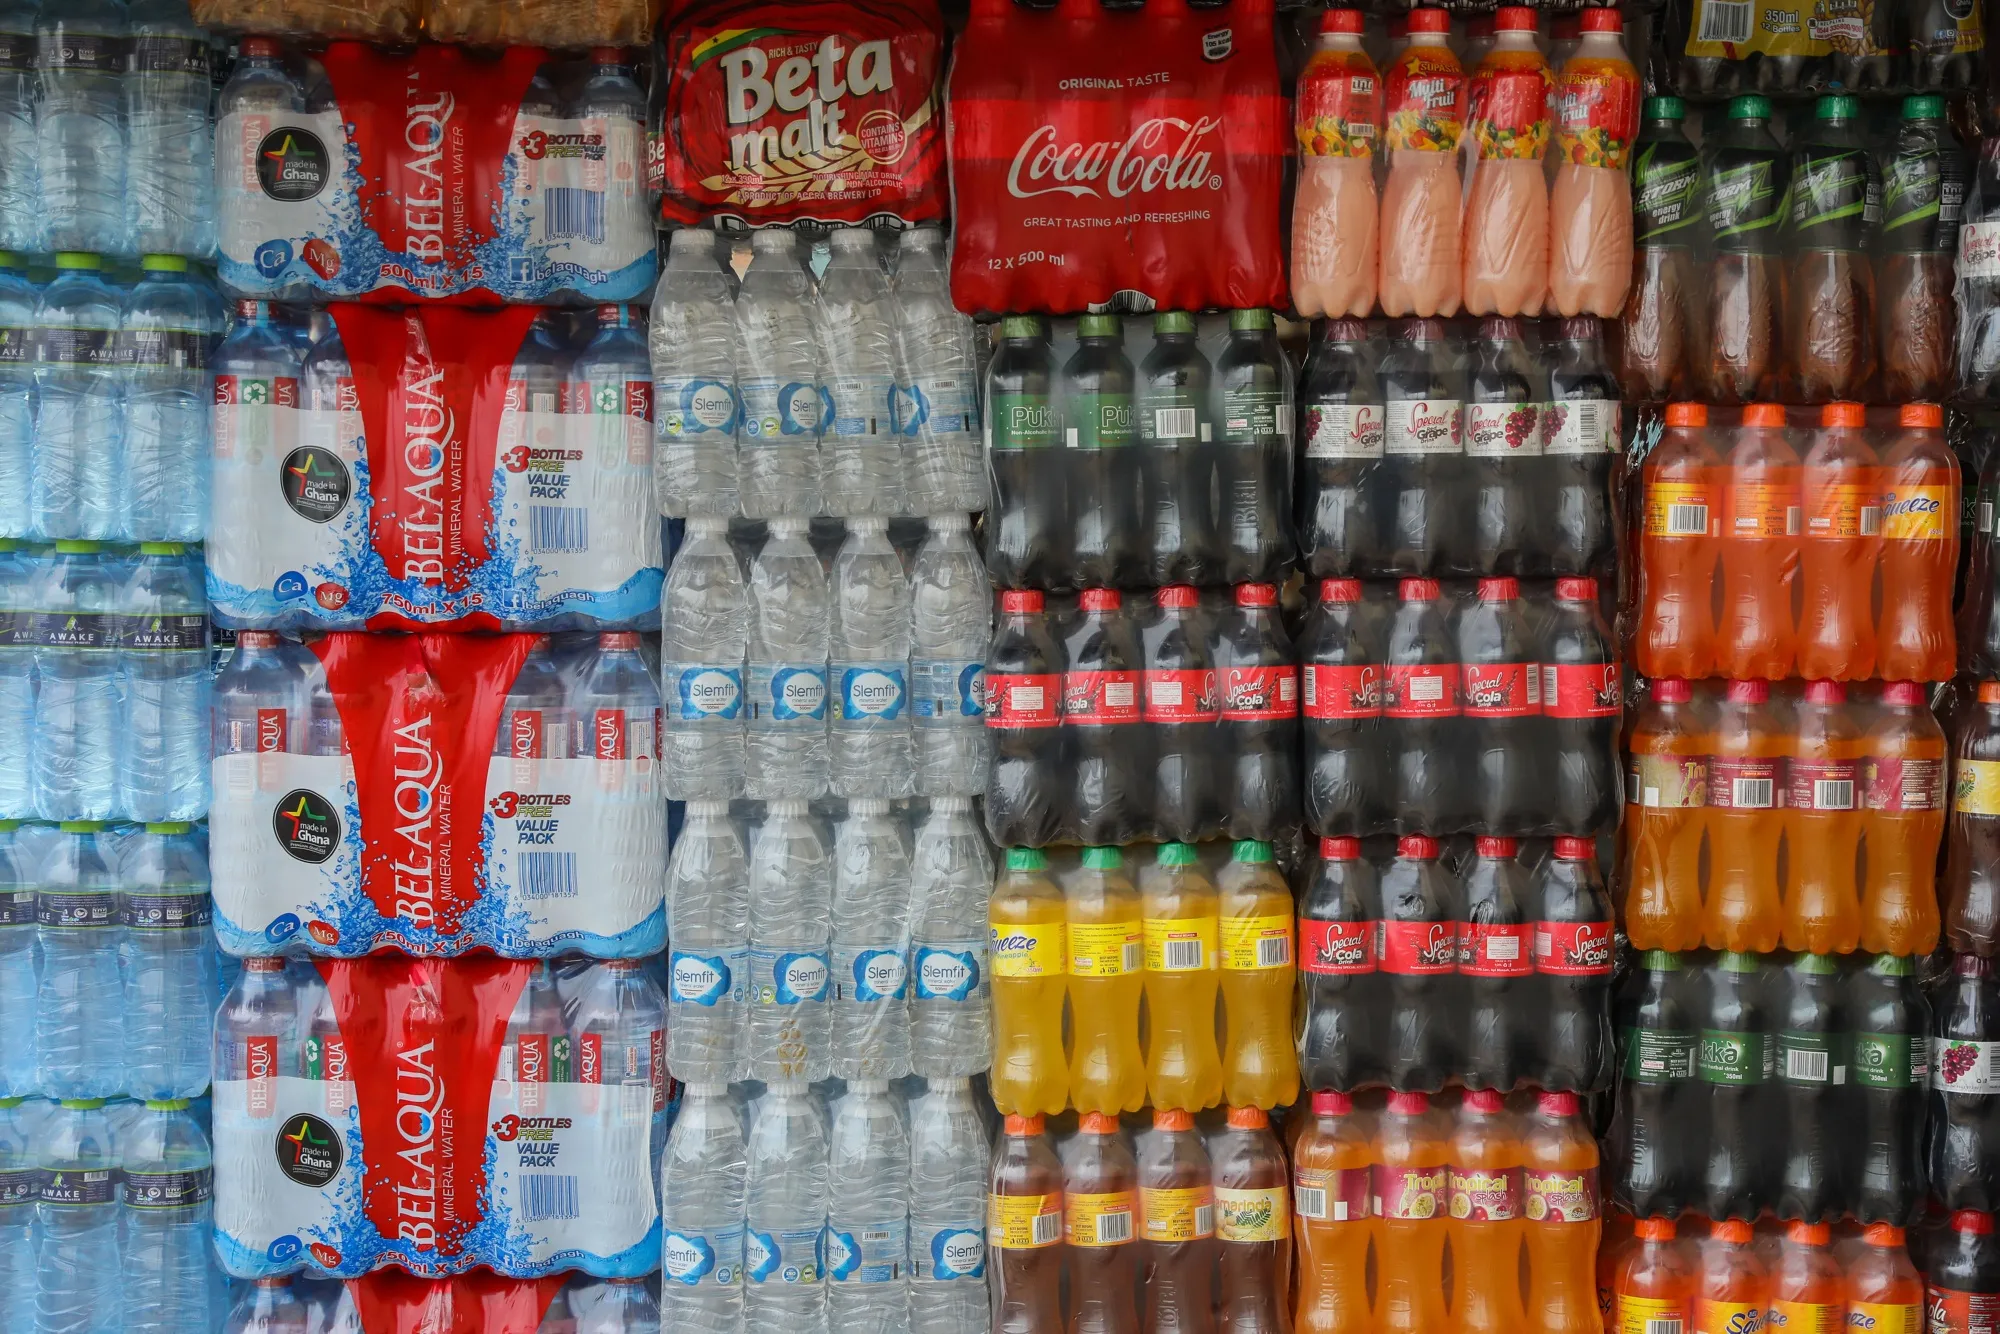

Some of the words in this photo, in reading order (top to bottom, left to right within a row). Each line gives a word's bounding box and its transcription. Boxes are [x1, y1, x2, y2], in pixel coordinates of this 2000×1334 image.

[1765, 10, 1800, 23] 350ml
[1207, 30, 1229, 39] Energy
[1761, 22, 1770, 30] 12
[1772, 24, 1801, 34] Bottles
[1218, 36, 1232, 45] kcal
[768, 46, 785, 59] RICH
[787, 45, 793, 56] &
[795, 41, 818, 54] TASTY
[720, 34, 893, 124] Beta
[1059, 77, 1123, 90] ORIGINAL
[1127, 71, 1170, 88] TASTE
[1409, 79, 1445, 98] Multi
[1424, 91, 1454, 108] Fruit
[730, 98, 847, 170] malt
[861, 121, 901, 138] CONTAINS
[547, 134, 602, 145] BOTTLES
[860, 133, 904, 149] VITAMINS
[452, 126, 464, 174] WATER
[545, 147, 583, 158] FREE
[285, 160, 308, 169] made
[310, 160, 317, 169] in
[283, 168, 319, 182] Ghana
[813, 172, 861, 181] NOURISHING
[861, 171, 880, 180] MALT
[881, 172, 902, 181] DRINK
[846, 180, 903, 189] NON-ALCOHOLIC
[1639, 173, 1696, 203] STORM
[784, 191, 794, 200] OF
[797, 191, 825, 200] ACCRA
[827, 189, 866, 200] BREWERY
[868, 188, 881, 198] LTD
[452, 179, 464, 238] MINERAL
[1652, 202, 1682, 217] energy
[1023, 217, 1062, 228] GREAT
[1065, 216, 1111, 228] TASTING
[1115, 213, 1141, 225] AND
[1144, 210, 1211, 222] REFRESHING
[1658, 211, 1680, 225] drink
[260, 249, 286, 268] Ca
[309, 249, 335, 273] Mg
[987, 257, 1001, 270] 12
[1018, 251, 1045, 266] 500
[1049, 253, 1065, 266] ml
[380, 263, 435, 289] 500ml
[462, 265, 482, 283] 15
[536, 262, 608, 284] belaquagh
[1407, 402, 1449, 438] Special
[1467, 405, 1504, 442] Special
[1417, 427, 1448, 440] Grape
[1474, 430, 1503, 443] Grape
[530, 449, 583, 461] BOTTLES
[450, 440, 462, 495] WATER
[527, 460, 564, 472] FREE
[307, 479, 327, 490] made
[328, 480, 337, 490] in
[527, 474, 570, 487] VALUE
[305, 486, 339, 502] Ghana
[530, 485, 566, 499] PACK
[450, 497, 462, 555] MINERAL
[278, 577, 302, 593] Ca
[319, 591, 343, 606] Mg
[381, 592, 435, 614] 750ml
[461, 592, 482, 607] 15
[524, 590, 596, 611] belaquagh
[50, 632, 94, 641] AWAKE
[134, 634, 179, 643] AWAKE
[693, 683, 734, 696] Slemfit
[786, 684, 823, 697] Slemfit
[853, 684, 895, 697] Slemfit
[1226, 669, 1265, 707] Special
[1466, 666, 1503, 704] Special
[1236, 693, 1264, 706] Cola
[1475, 690, 1502, 702] Cola
[518, 794, 571, 806] BOTTLES
[440, 784, 452, 840] WATER
[516, 806, 553, 817] FREE
[300, 821, 318, 832] made
[319, 824, 328, 833] in
[515, 819, 559, 832] VALUE
[298, 830, 330, 846] Ghana
[517, 832, 554, 845] PACK
[440, 842, 452, 901] MINERAL
[270, 921, 295, 937] Ca
[313, 926, 334, 942] Mg
[371, 931, 427, 954] 750ml
[453, 934, 473, 950] 15
[515, 930, 585, 949] belaquagh
[1322, 924, 1365, 962] Special
[1570, 925, 1610, 963] Special
[1335, 948, 1362, 960] Cola
[1585, 949, 1608, 962] Cola
[675, 969, 714, 983] Slemfit
[788, 967, 825, 982] Slemfit
[923, 965, 965, 978] Slemfit
[520, 1117, 572, 1129] BOTTLES
[443, 1107, 454, 1162] WATER
[517, 1129, 553, 1140] FREE
[302, 1146, 321, 1157] made
[323, 1148, 330, 1157] in
[516, 1143, 559, 1155] VALUE
[300, 1153, 332, 1168] Ghana
[519, 1155, 556, 1167] PACK
[42, 1190, 80, 1198] AWAKE
[443, 1165, 454, 1221] MINERAL
[1475, 1189, 1507, 1205] splash
[1551, 1191, 1583, 1205] splash
[273, 1243, 296, 1258] Ca
[315, 1249, 336, 1264] Mg
[376, 1251, 428, 1273] 750ml
[454, 1253, 474, 1269] 15
